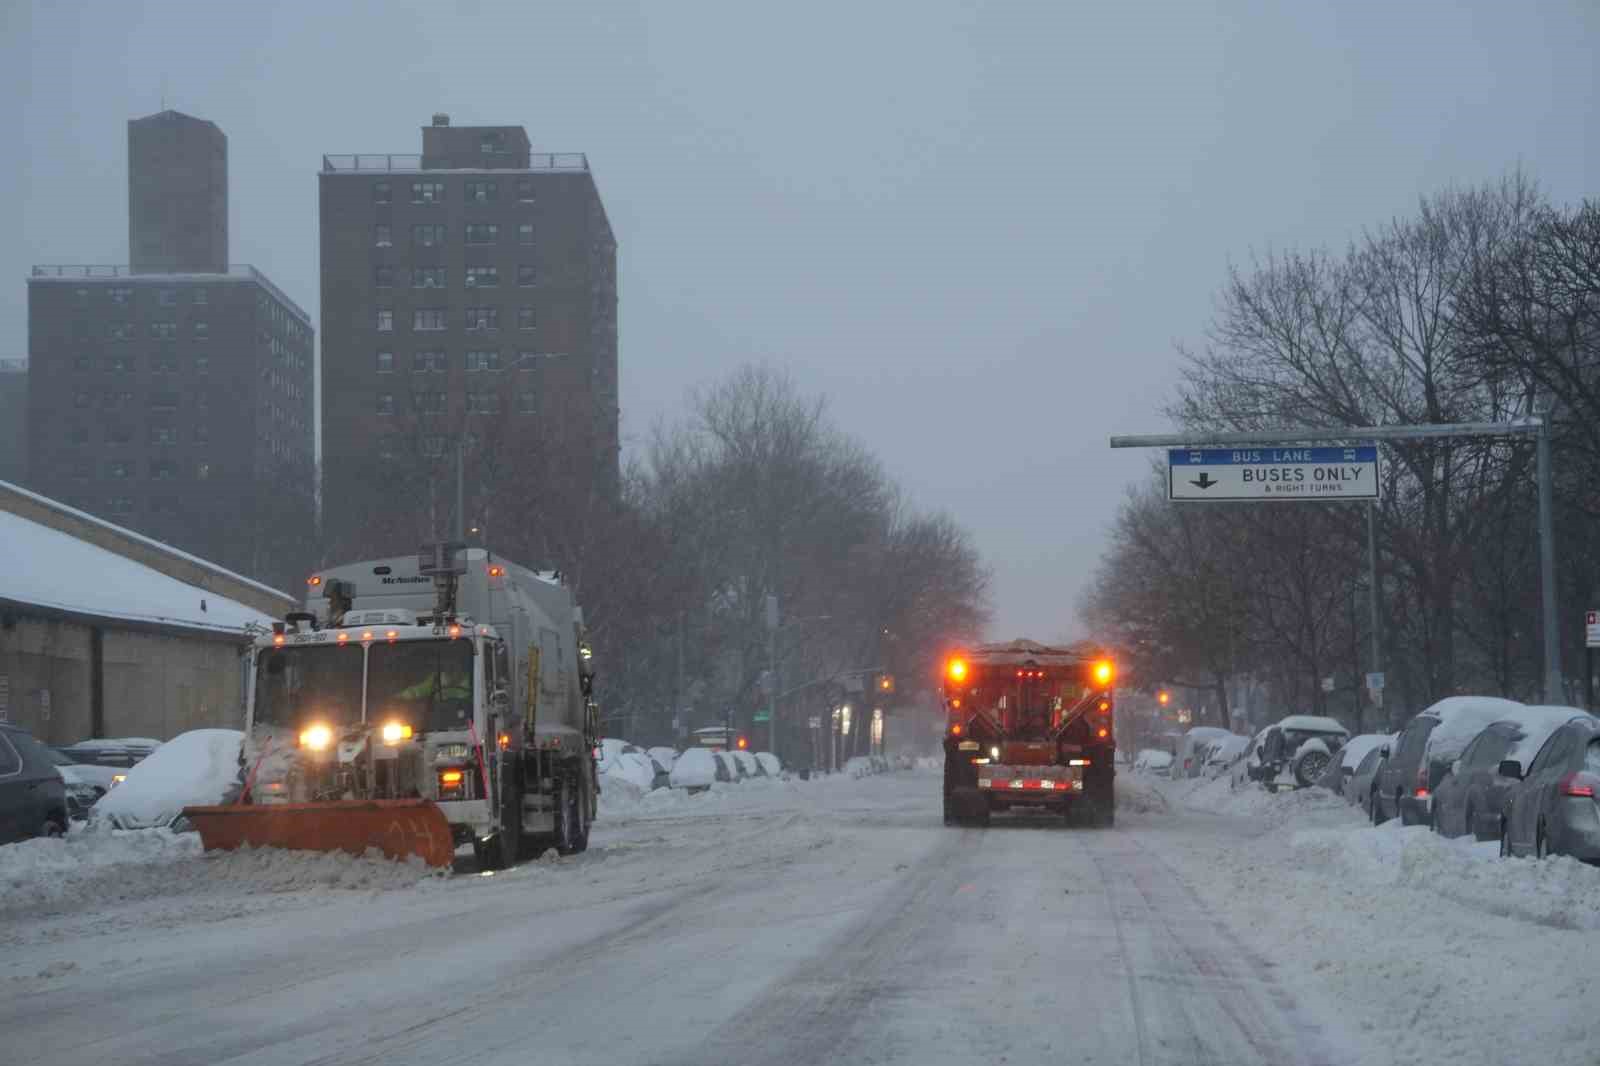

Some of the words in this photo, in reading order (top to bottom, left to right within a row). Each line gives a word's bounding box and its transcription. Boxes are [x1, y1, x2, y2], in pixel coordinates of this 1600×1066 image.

[1232, 450, 1261, 462] BUS
[1272, 449, 1312, 462] LANE
[1242, 467, 1305, 482] BUSES
[1313, 467, 1362, 481] ONLY
[1275, 484, 1305, 493] RIGHT
[1310, 483, 1343, 492] TURNS
